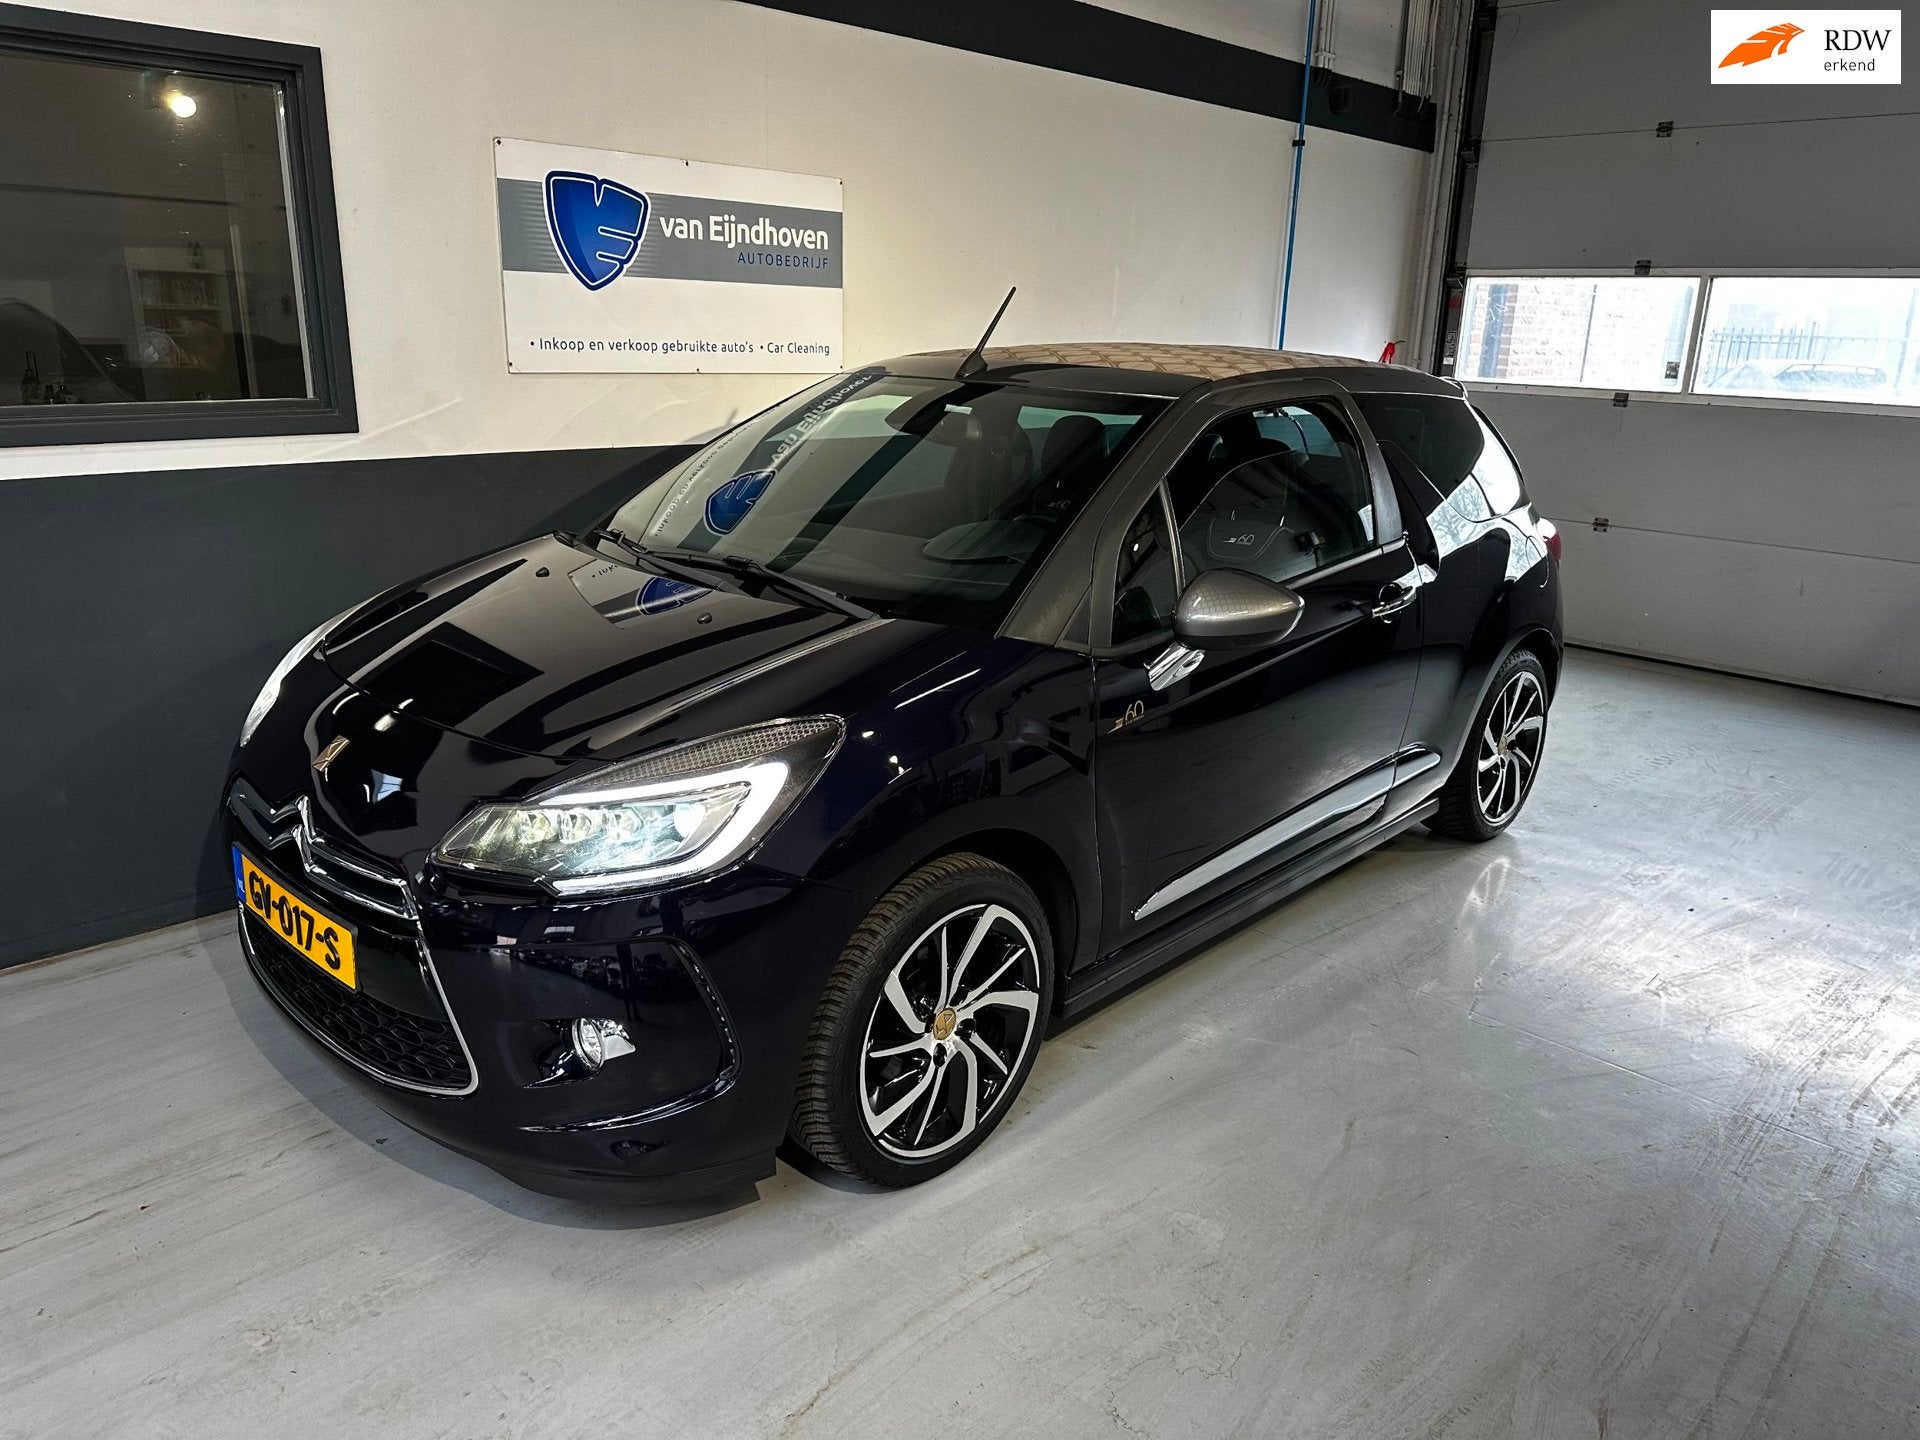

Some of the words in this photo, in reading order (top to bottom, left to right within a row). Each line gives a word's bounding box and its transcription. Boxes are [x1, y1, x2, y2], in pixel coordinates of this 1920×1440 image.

[660, 216, 703, 240] van
[709, 214, 829, 250] Eijndhoven
[737, 252, 829, 269] AUTOBEDRIJF
[539, 337, 585, 352] Inkoop
[589, 339, 605, 350] en
[608, 339, 659, 355] verkoop
[661, 341, 719, 355] gebruikte
[721, 342, 755, 353] auto's
[766, 343, 784, 354] Car
[787, 343, 830, 356] Cleaning
[1125, 700, 1144, 719] 60
[248, 870, 341, 970] GV-017-S
